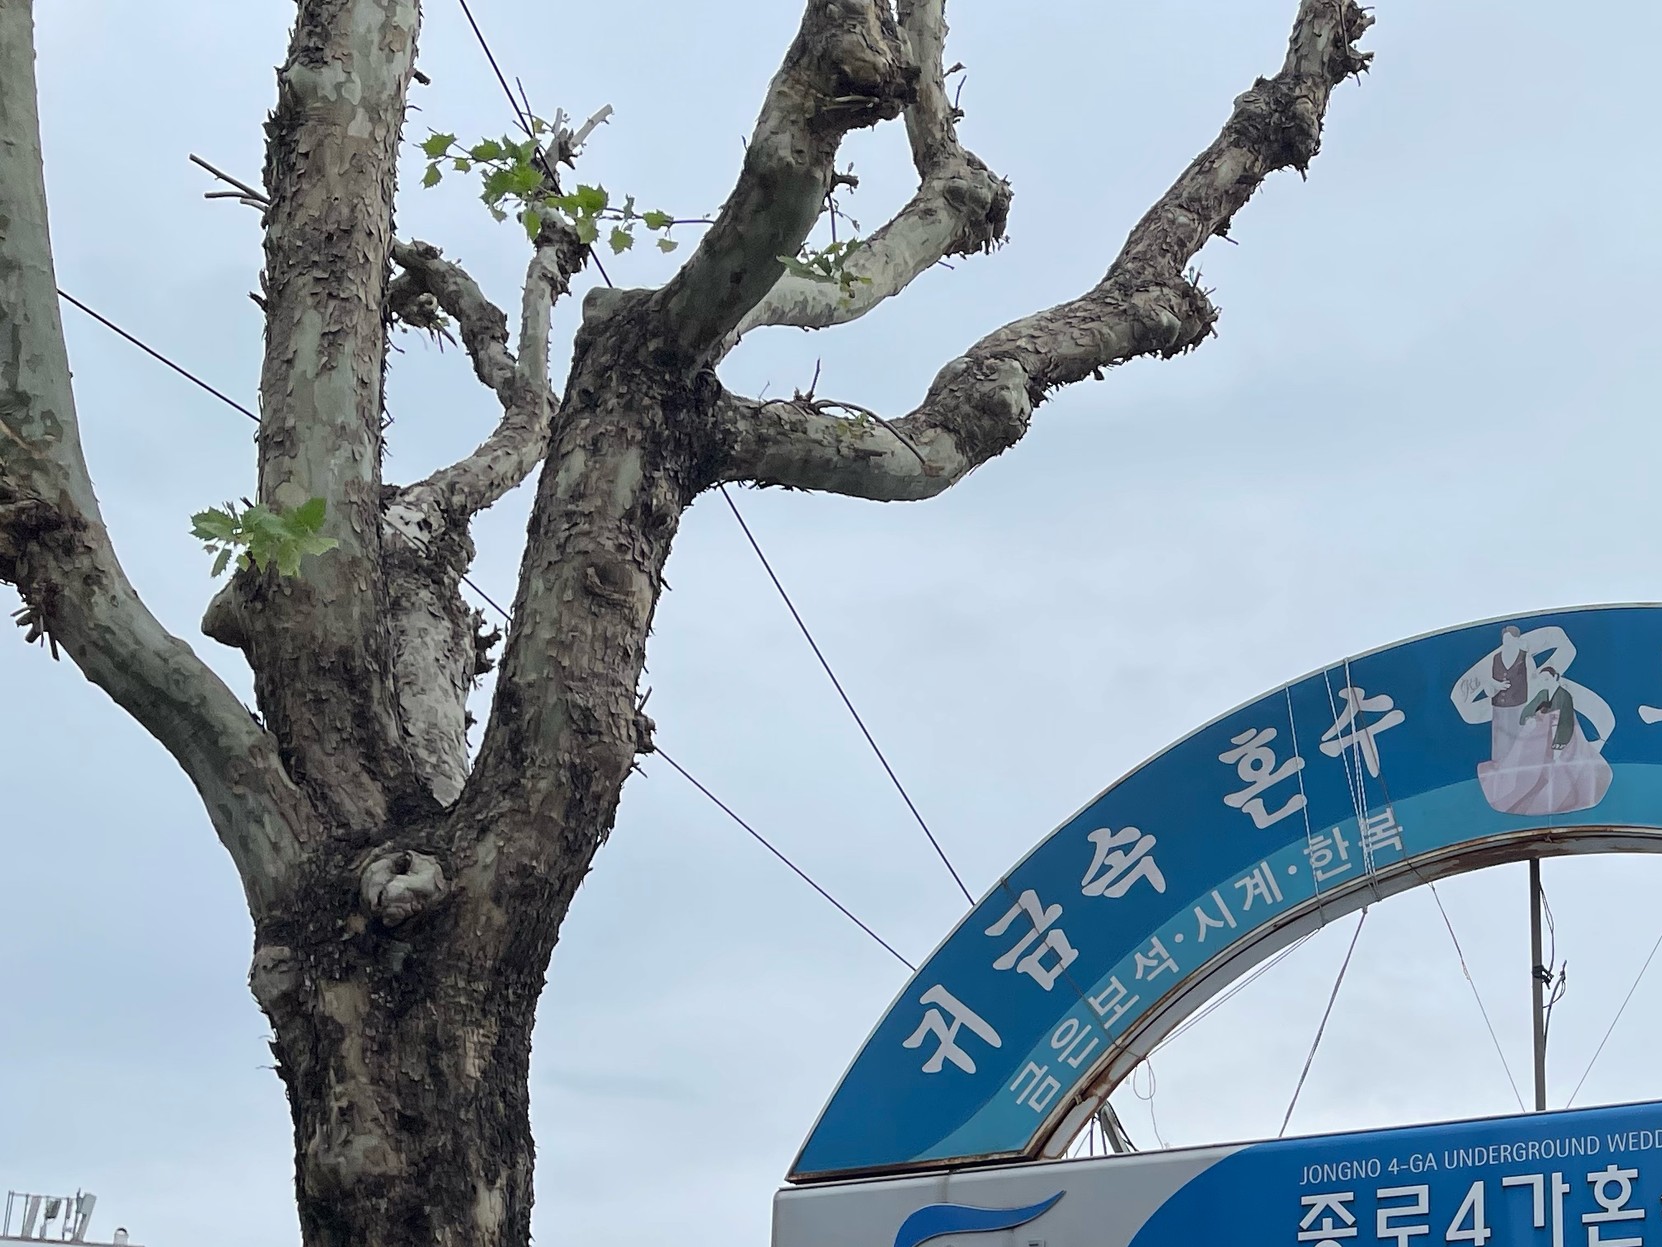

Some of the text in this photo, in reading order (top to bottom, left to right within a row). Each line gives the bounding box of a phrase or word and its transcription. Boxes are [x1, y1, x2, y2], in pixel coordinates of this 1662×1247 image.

[1219, 686, 1405, 829] 혼수
[1302, 1157, 1380, 1185] JONGNO
[1387, 1149, 1438, 1173] 4-GA
[1444, 1134, 1600, 1169] UNDERGROUND
